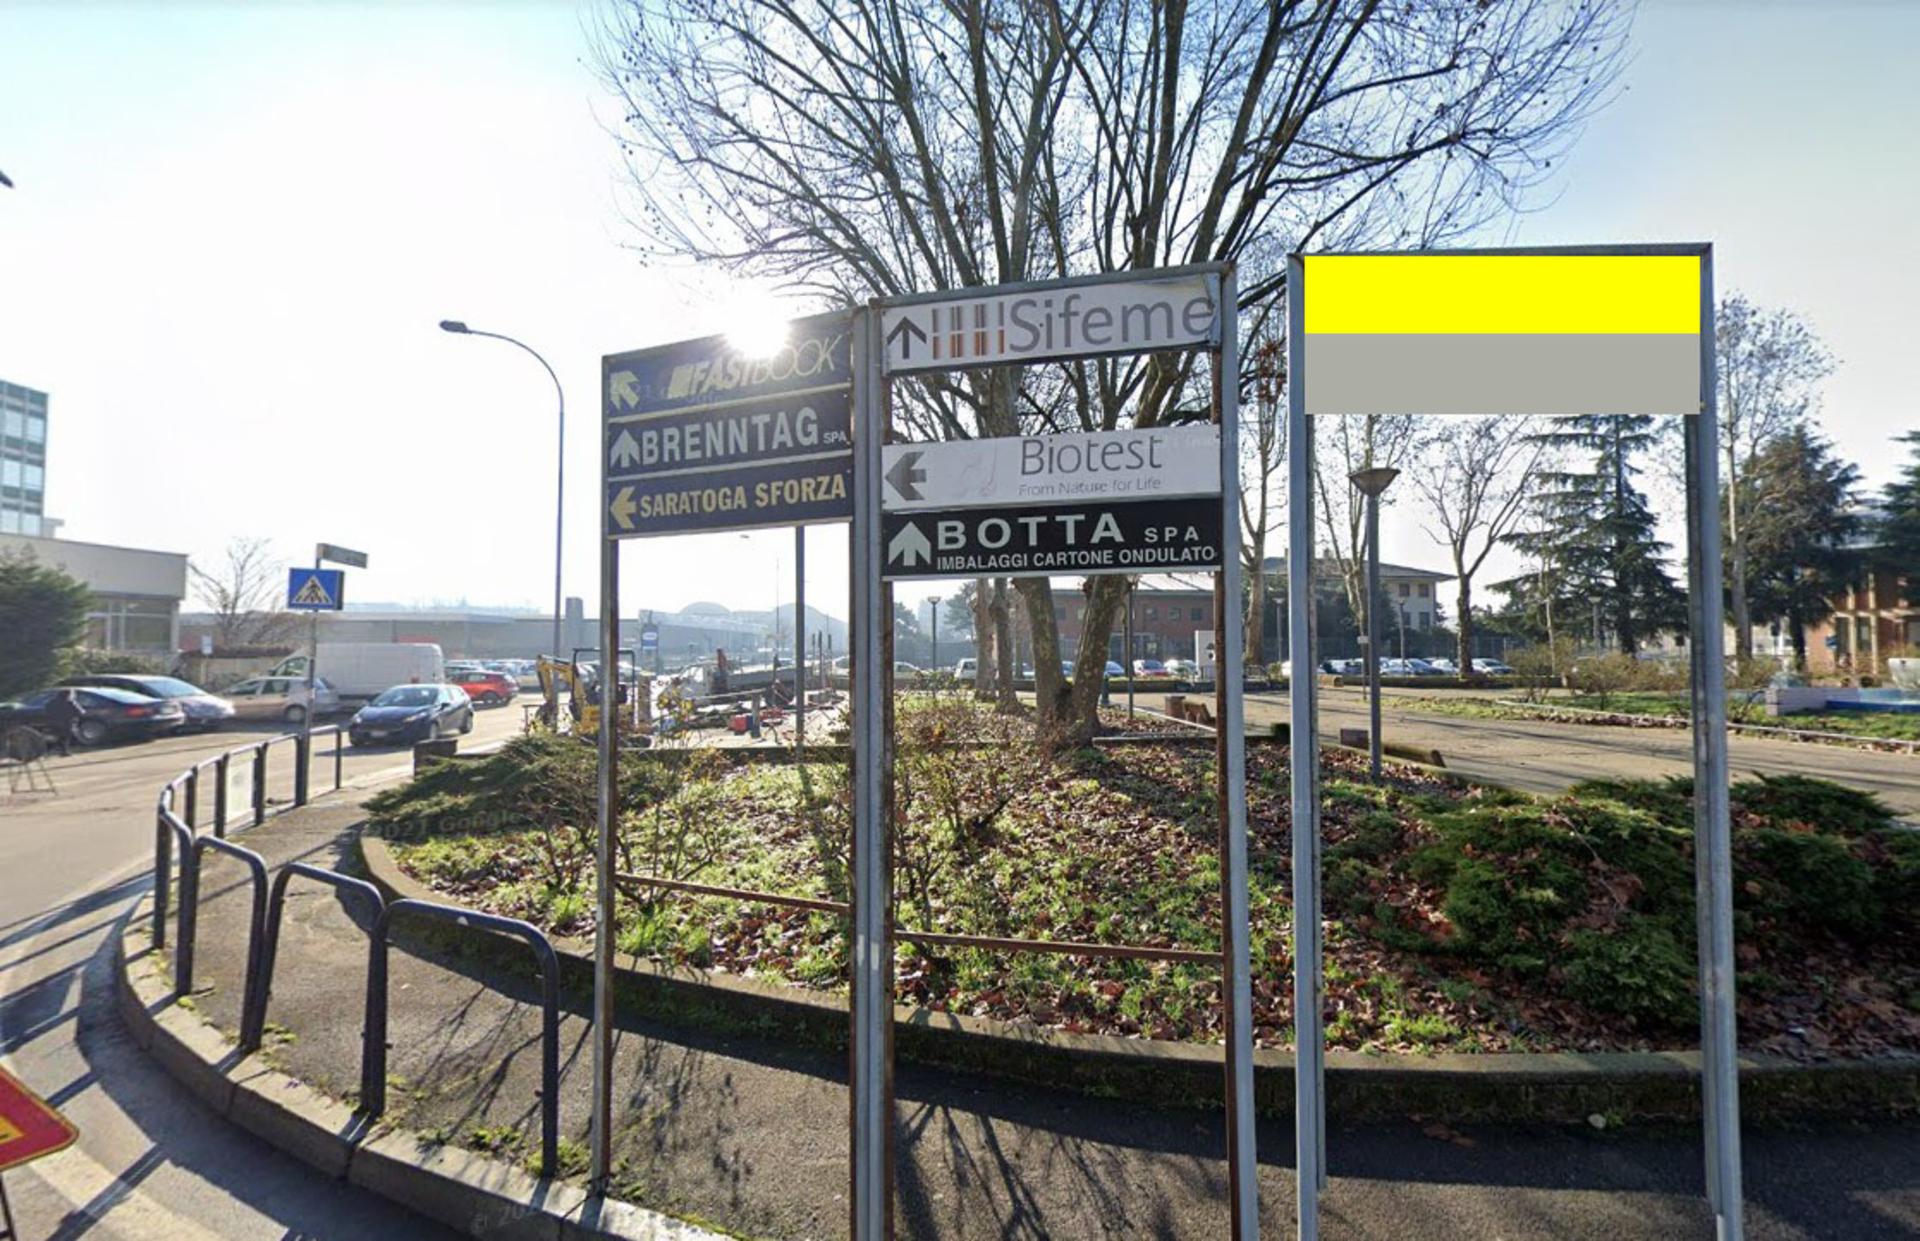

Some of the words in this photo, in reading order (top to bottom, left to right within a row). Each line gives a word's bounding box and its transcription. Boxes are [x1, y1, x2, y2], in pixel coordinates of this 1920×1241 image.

[1009, 294, 1214, 352] Sifeme
[642, 407, 818, 465] BRENNTAG
[823, 431, 847, 444] SPA
[1021, 435, 1163, 475] Biotest
[640, 486, 747, 518] SARATOGA
[755, 474, 846, 508] SFORZA
[1019, 484, 1054, 496] From
[1059, 481, 1107, 494] Nature
[1113, 479, 1132, 491] for
[1137, 477, 1161, 490] Life
[937, 513, 1125, 550] BOTTA
[1144, 526, 1199, 543] SPA
[937, 553, 1028, 570] IMBALAGGI
[1033, 550, 1114, 566] CARTONE
[1119, 546, 1215, 563] ONDULATO
